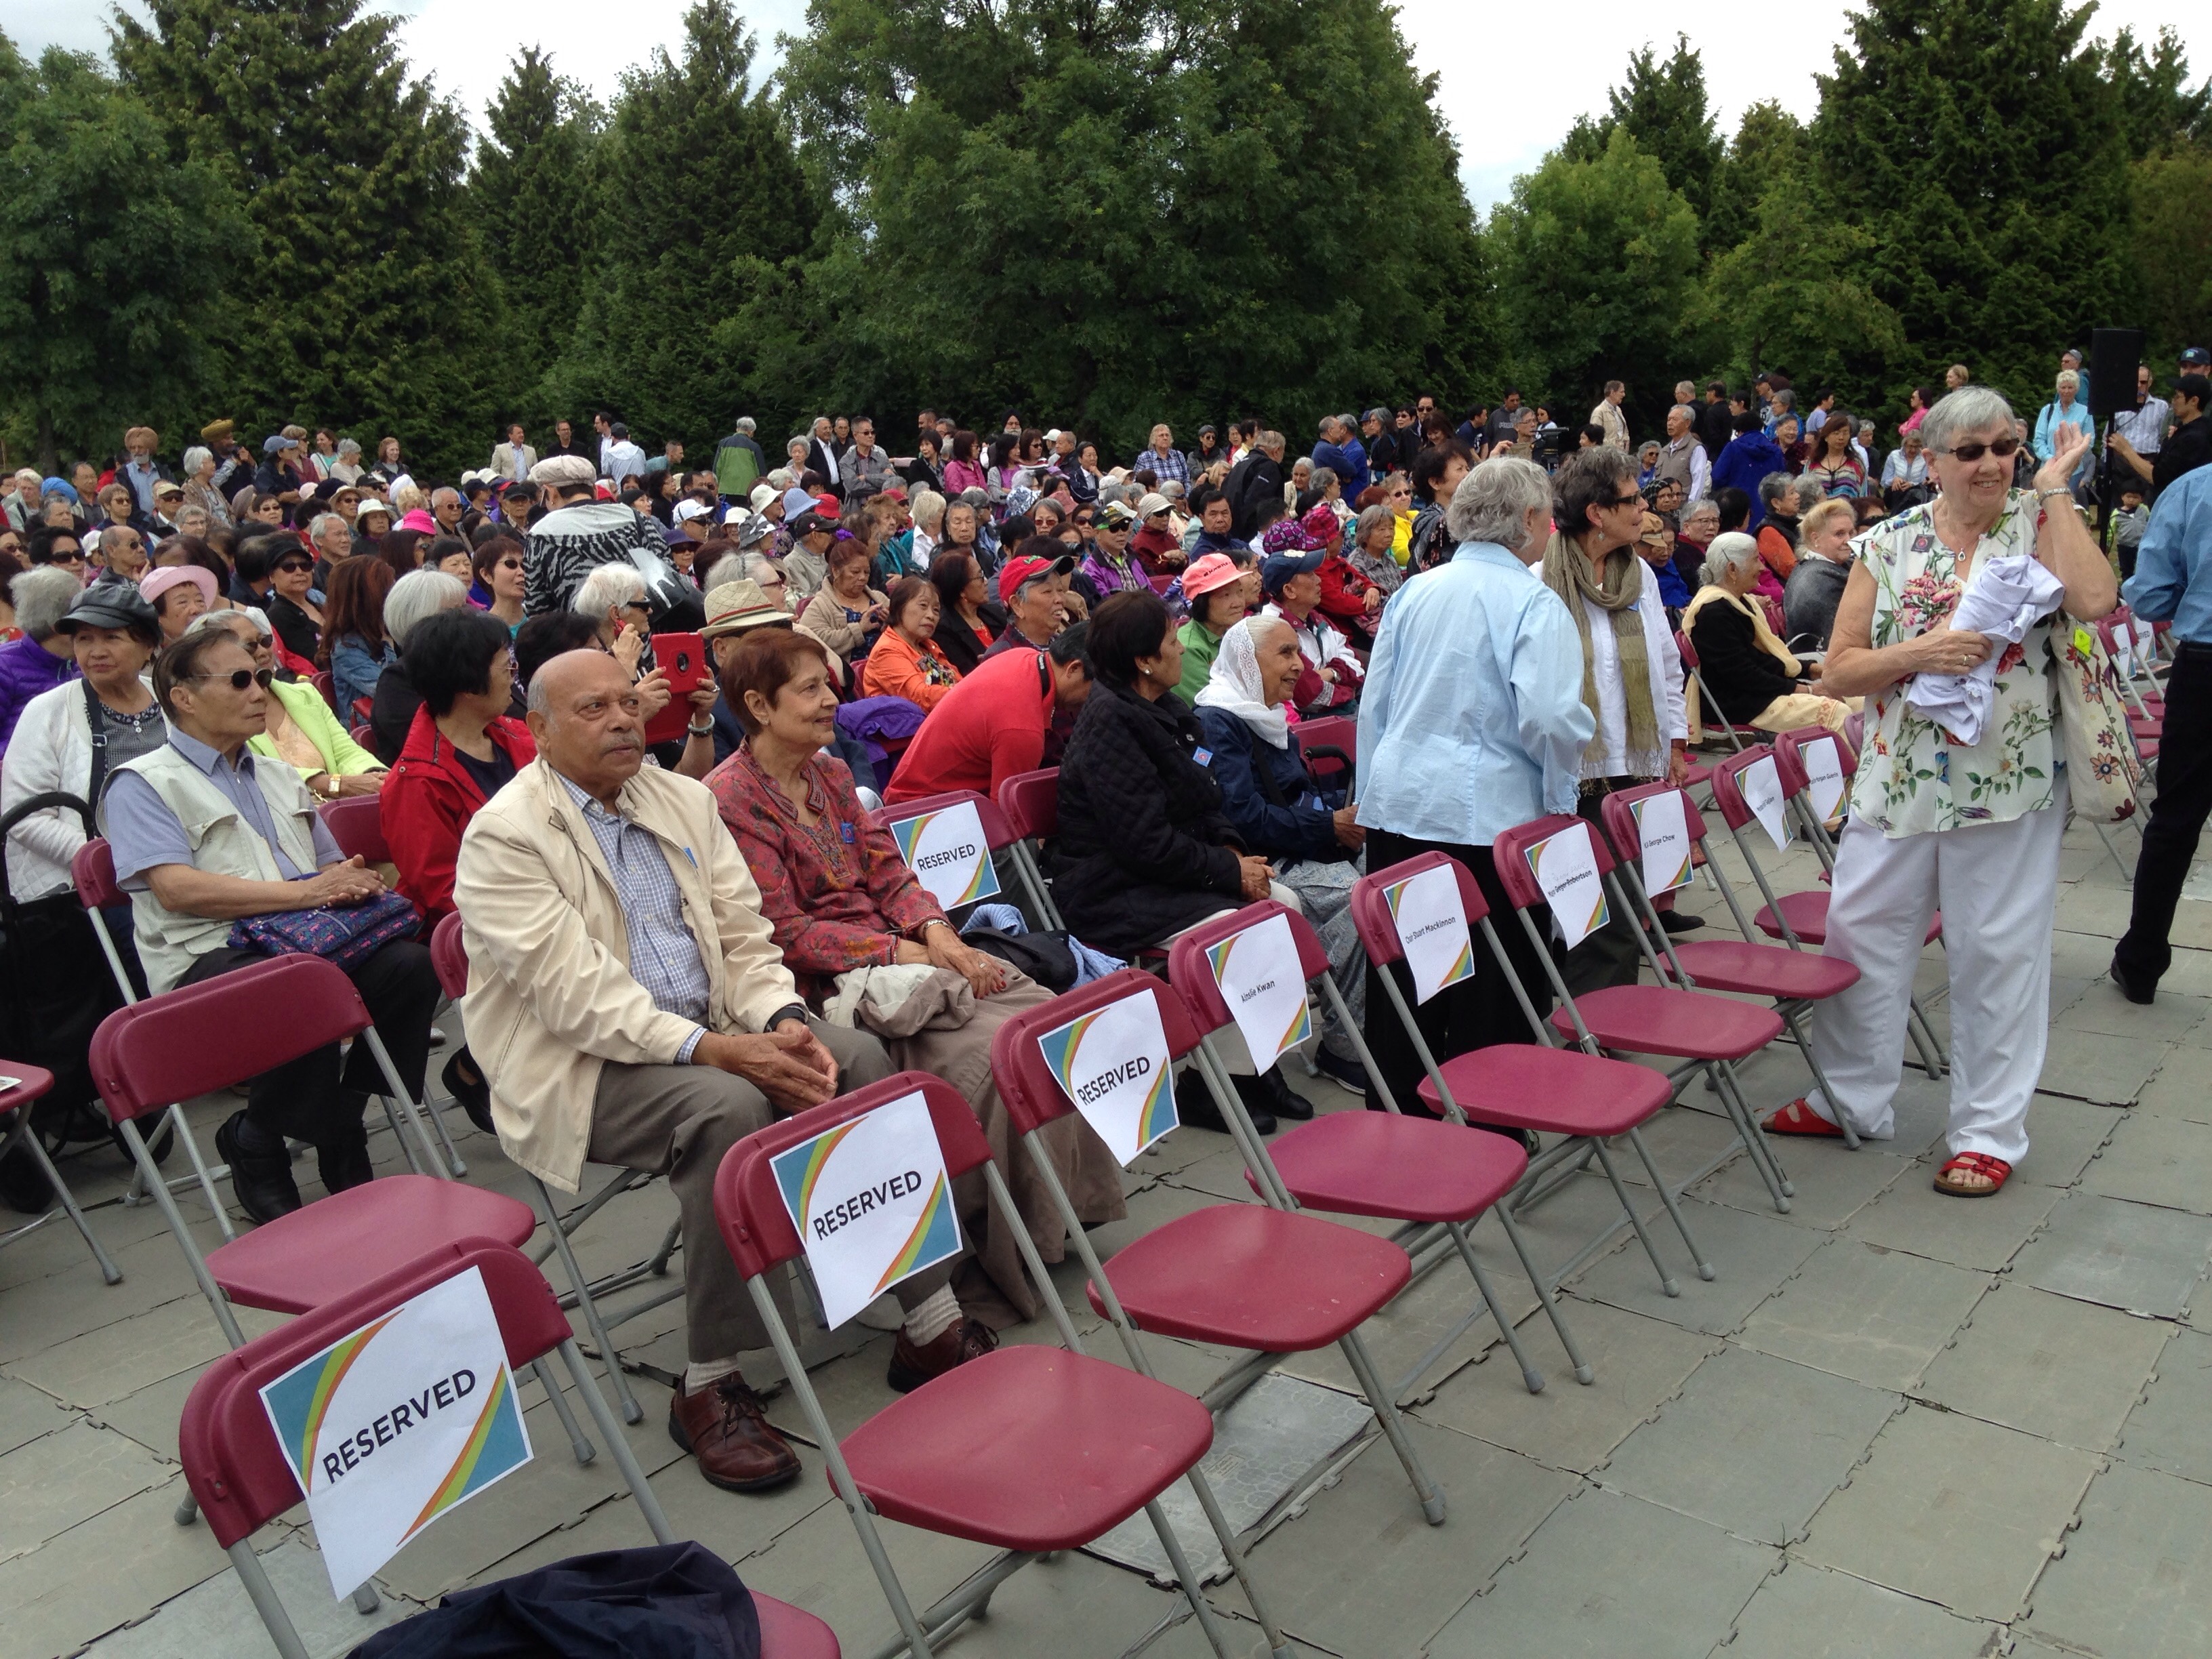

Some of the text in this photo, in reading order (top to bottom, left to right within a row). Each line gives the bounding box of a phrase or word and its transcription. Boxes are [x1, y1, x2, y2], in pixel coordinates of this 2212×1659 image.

[1662, 834, 1675, 842] Chow
[917, 844, 976, 872] RESERVED
[1566, 869, 1593, 886] Robertson
[1412, 927, 1425, 940] Stuart
[1241, 980, 1275, 1003] Ainslie Kwan
[1077, 1056, 1150, 1106] RESERVED
[813, 1170, 922, 1241] RESERVED
[323, 1369, 476, 1484] RESERVED
